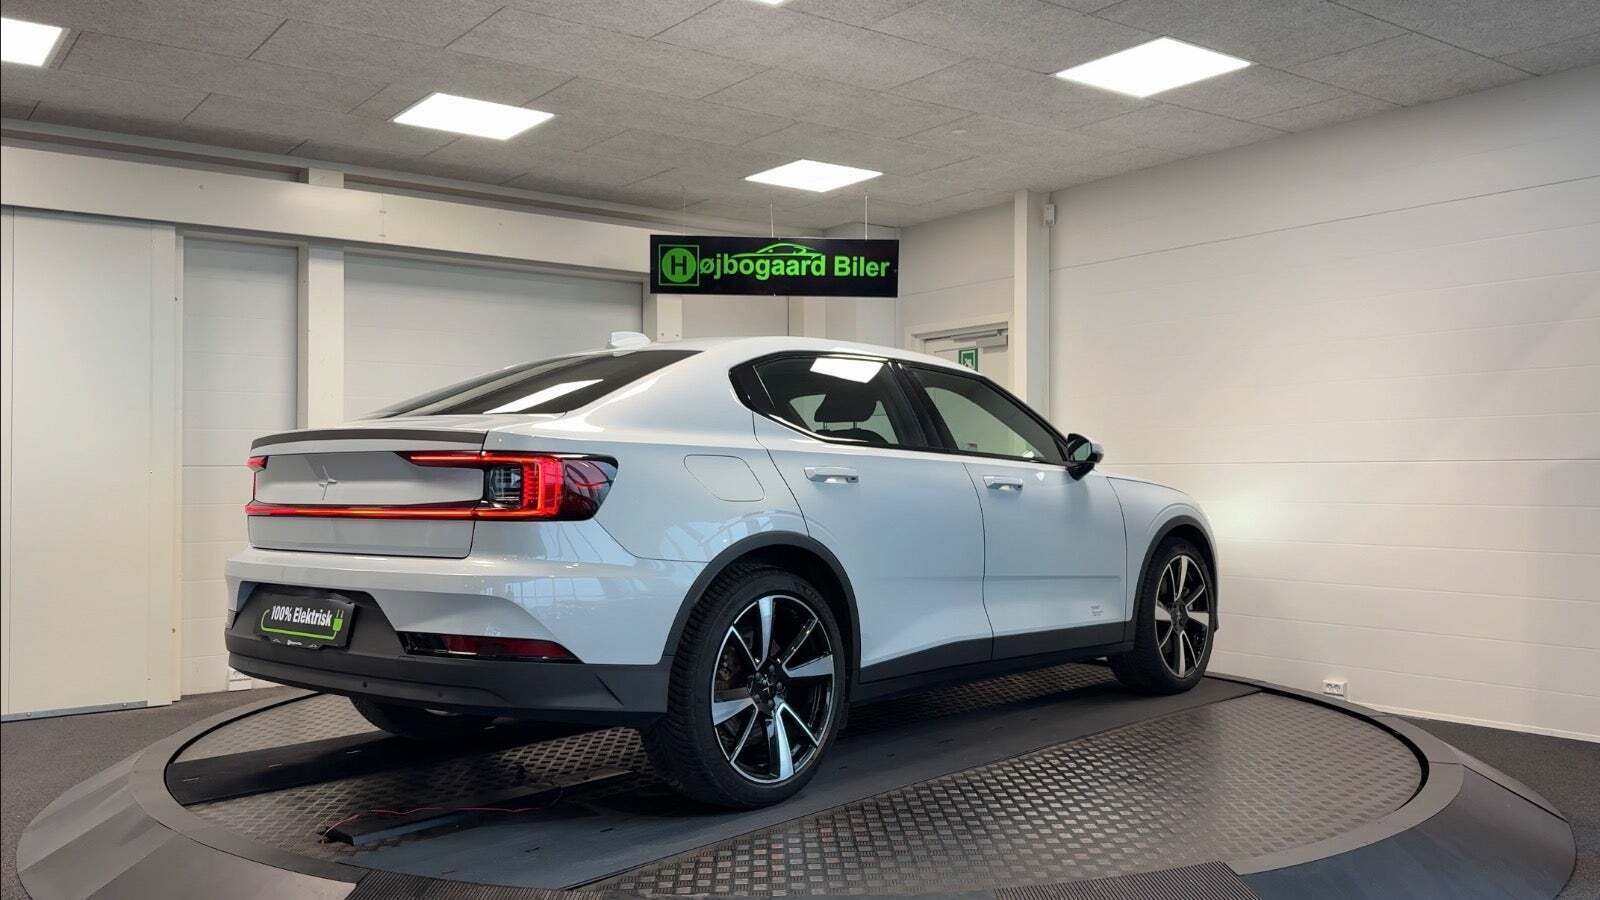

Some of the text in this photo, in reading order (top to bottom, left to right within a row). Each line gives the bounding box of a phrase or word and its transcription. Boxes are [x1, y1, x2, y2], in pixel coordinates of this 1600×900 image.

[669, 253, 890, 281] Højbogaard Biler
[271, 605, 333, 627] 100% Elektrisk
